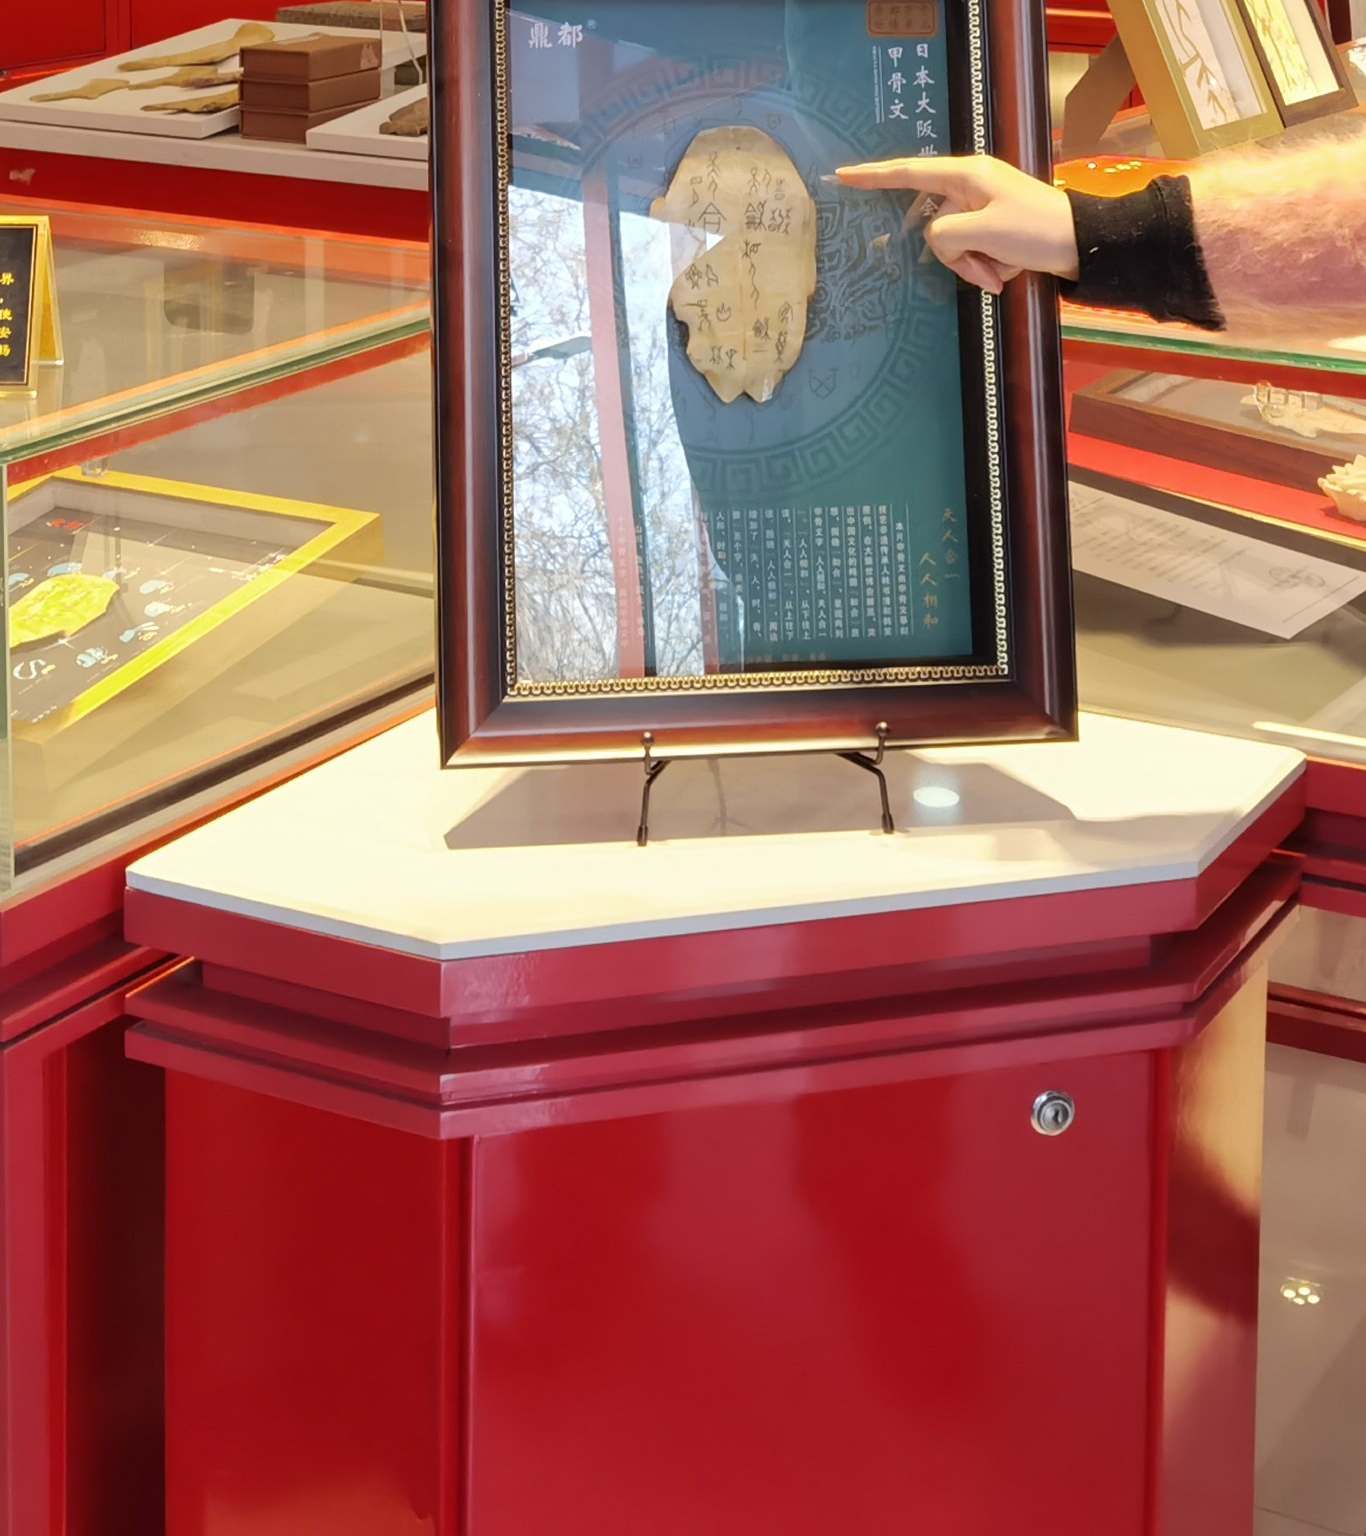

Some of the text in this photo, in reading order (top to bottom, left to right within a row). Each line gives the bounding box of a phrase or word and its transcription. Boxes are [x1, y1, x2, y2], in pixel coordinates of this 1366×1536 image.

[528, 21, 583, 49] 鼎都
[888, 46, 909, 120] 甲骨文
